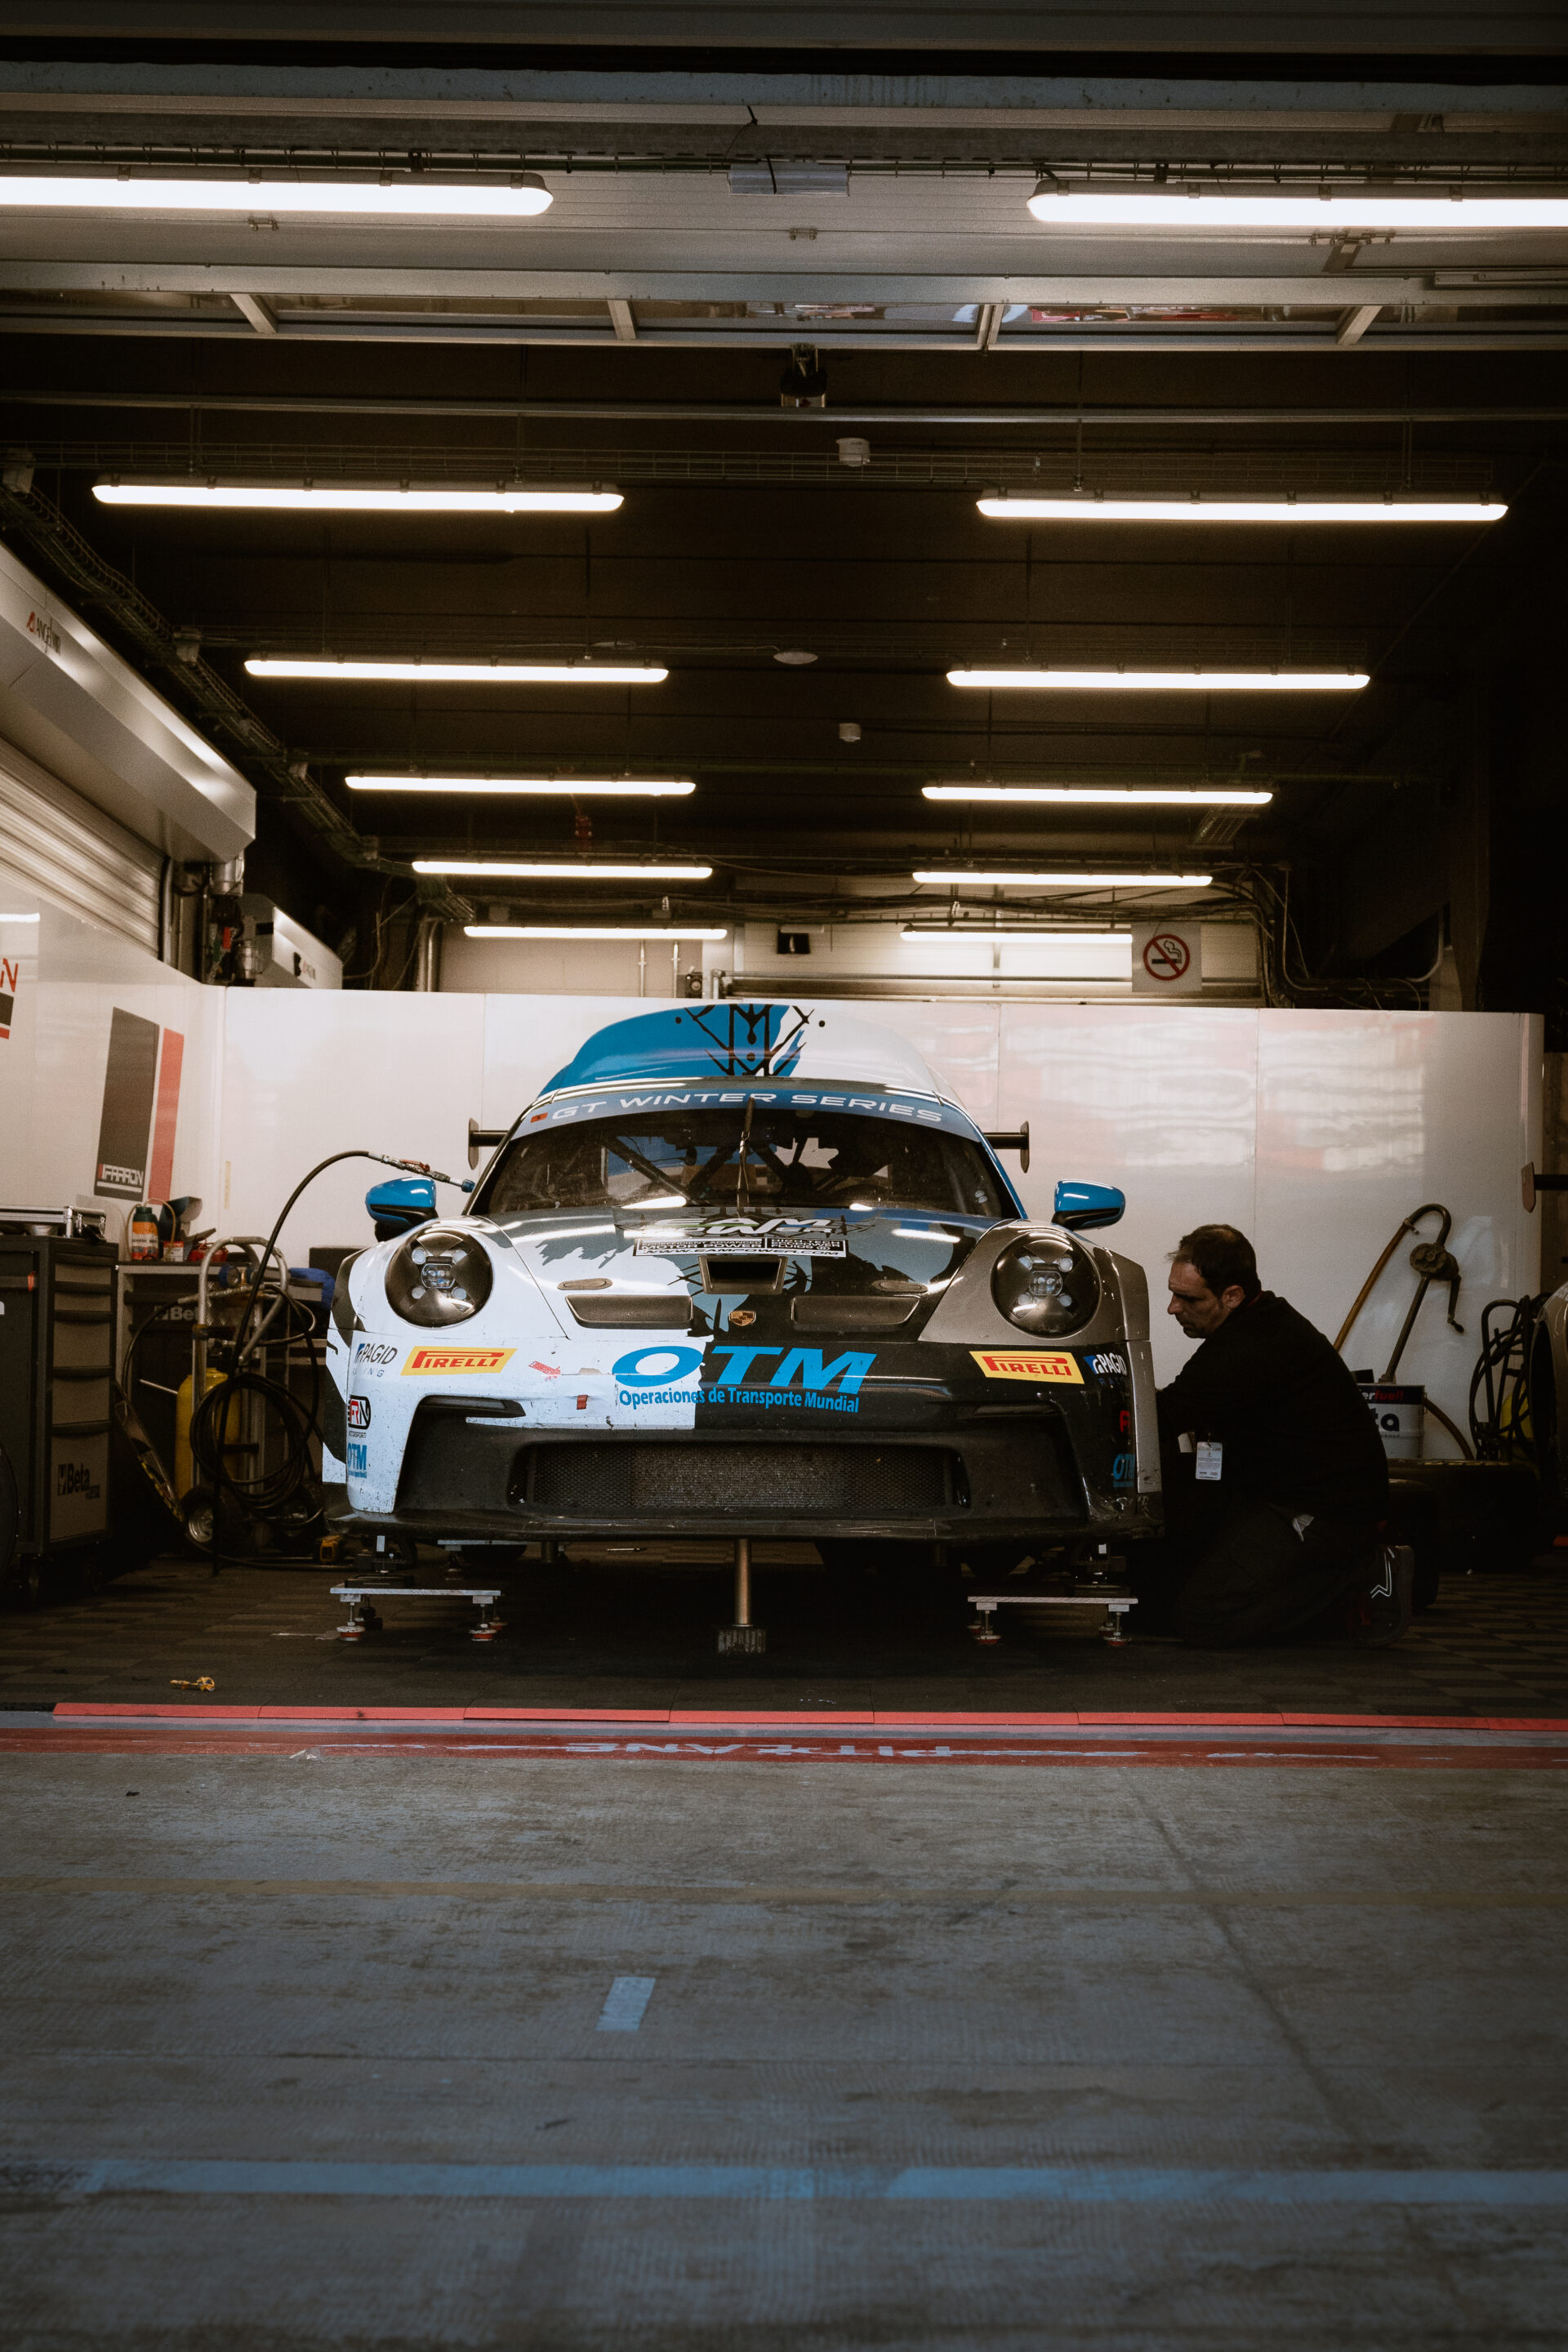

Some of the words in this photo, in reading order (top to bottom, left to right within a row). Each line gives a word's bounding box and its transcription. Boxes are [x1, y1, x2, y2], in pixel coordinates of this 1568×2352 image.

[552, 1101, 608, 1120] GT
[620, 1093, 778, 1109] WINTER
[791, 1094, 943, 1122] SERIES
[170, 1305, 198, 1321] Bet
[412, 1351, 505, 1369] PIRELLI
[612, 1345, 877, 1395] OTM
[982, 1356, 1071, 1376] PIRELLI
[619, 1387, 705, 1410] Operaciones
[708, 1387, 725, 1403] de
[727, 1387, 802, 1409] Transporte
[804, 1392, 860, 1413] Mundial
[67, 1463, 90, 1494] Beta
